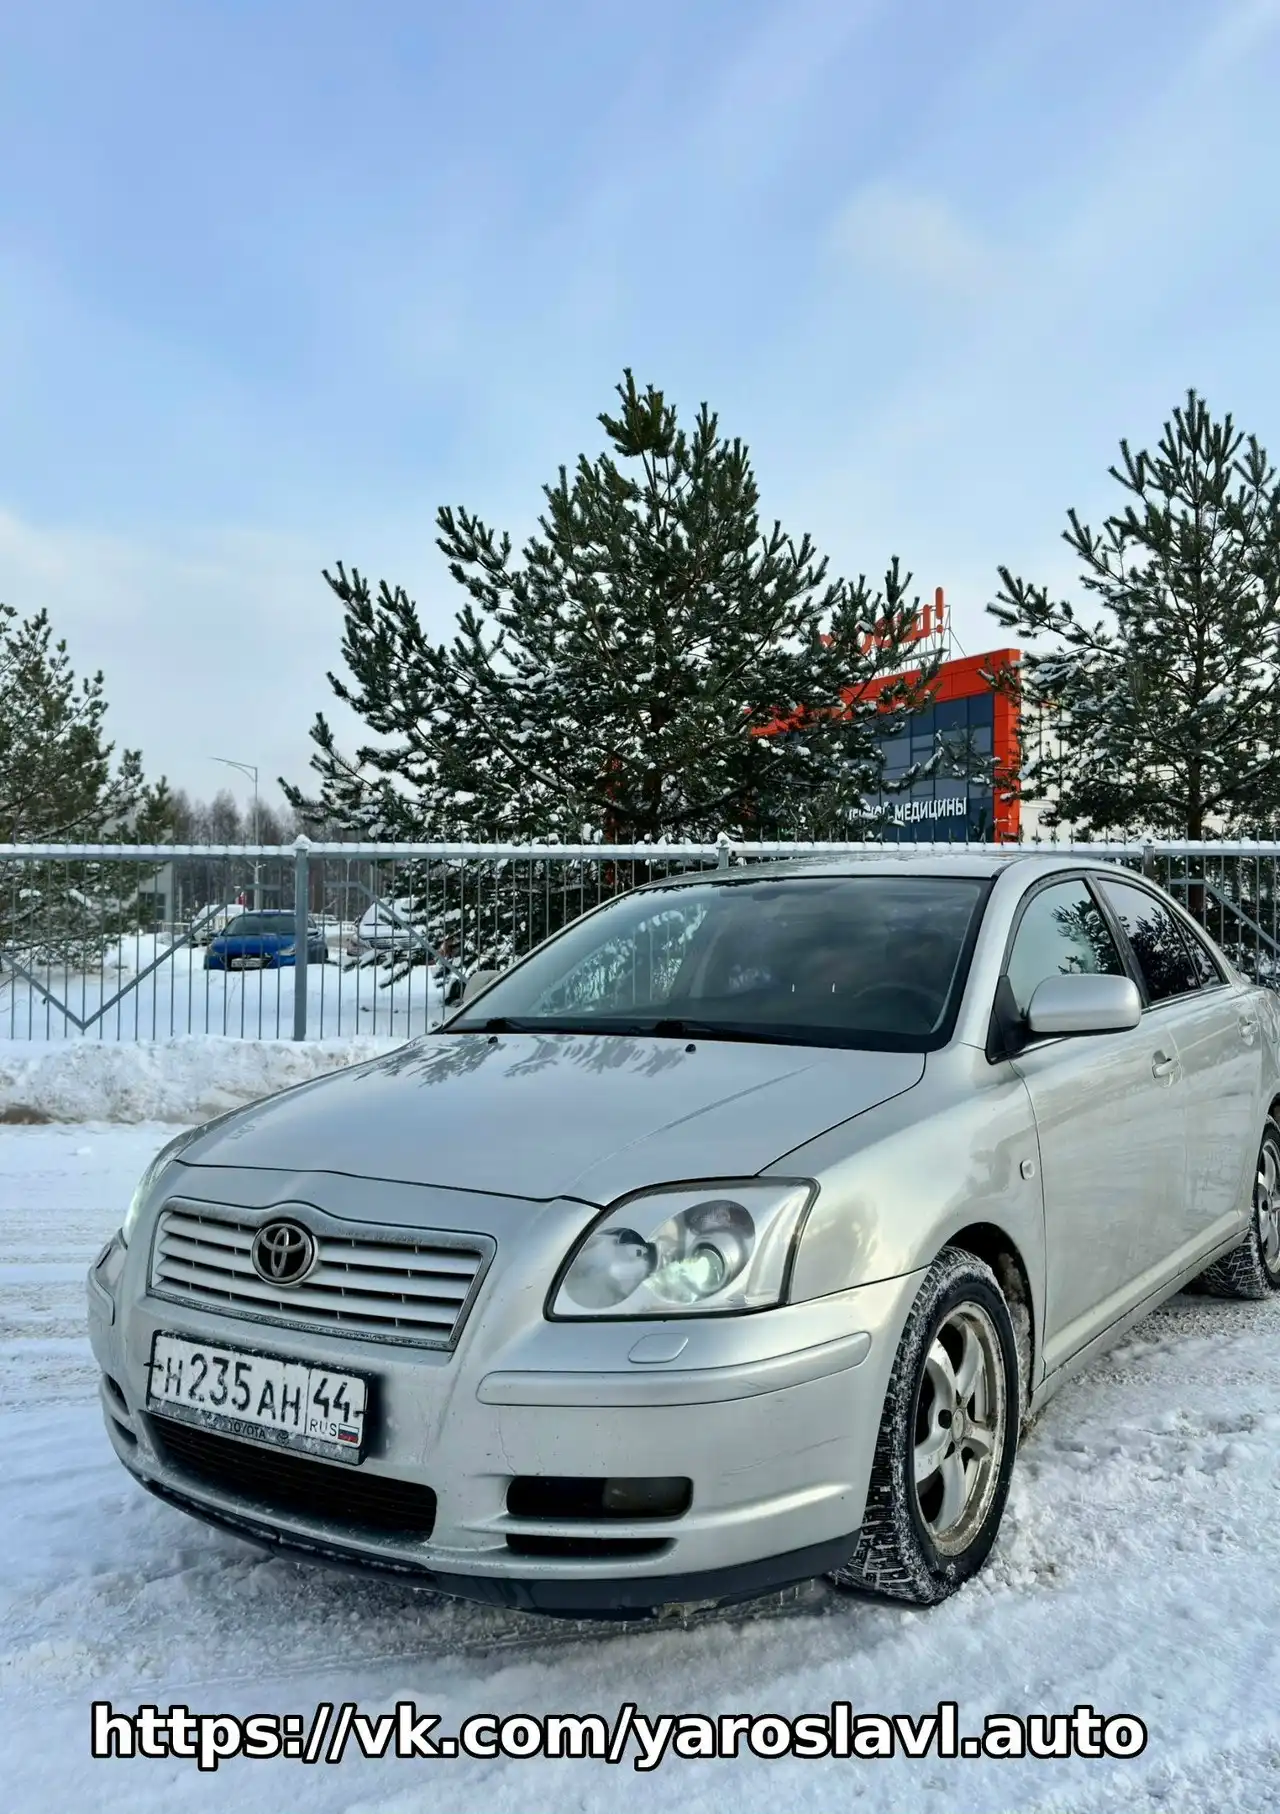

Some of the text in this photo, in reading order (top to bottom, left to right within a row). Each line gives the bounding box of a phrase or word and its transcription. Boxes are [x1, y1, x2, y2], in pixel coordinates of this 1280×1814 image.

[894, 797, 967, 823] МЕДИЦИНЫ
[313, 1377, 351, 1423] 44
[228, 1420, 266, 1439] TOYOTA
[309, 1418, 337, 1437] RUS
